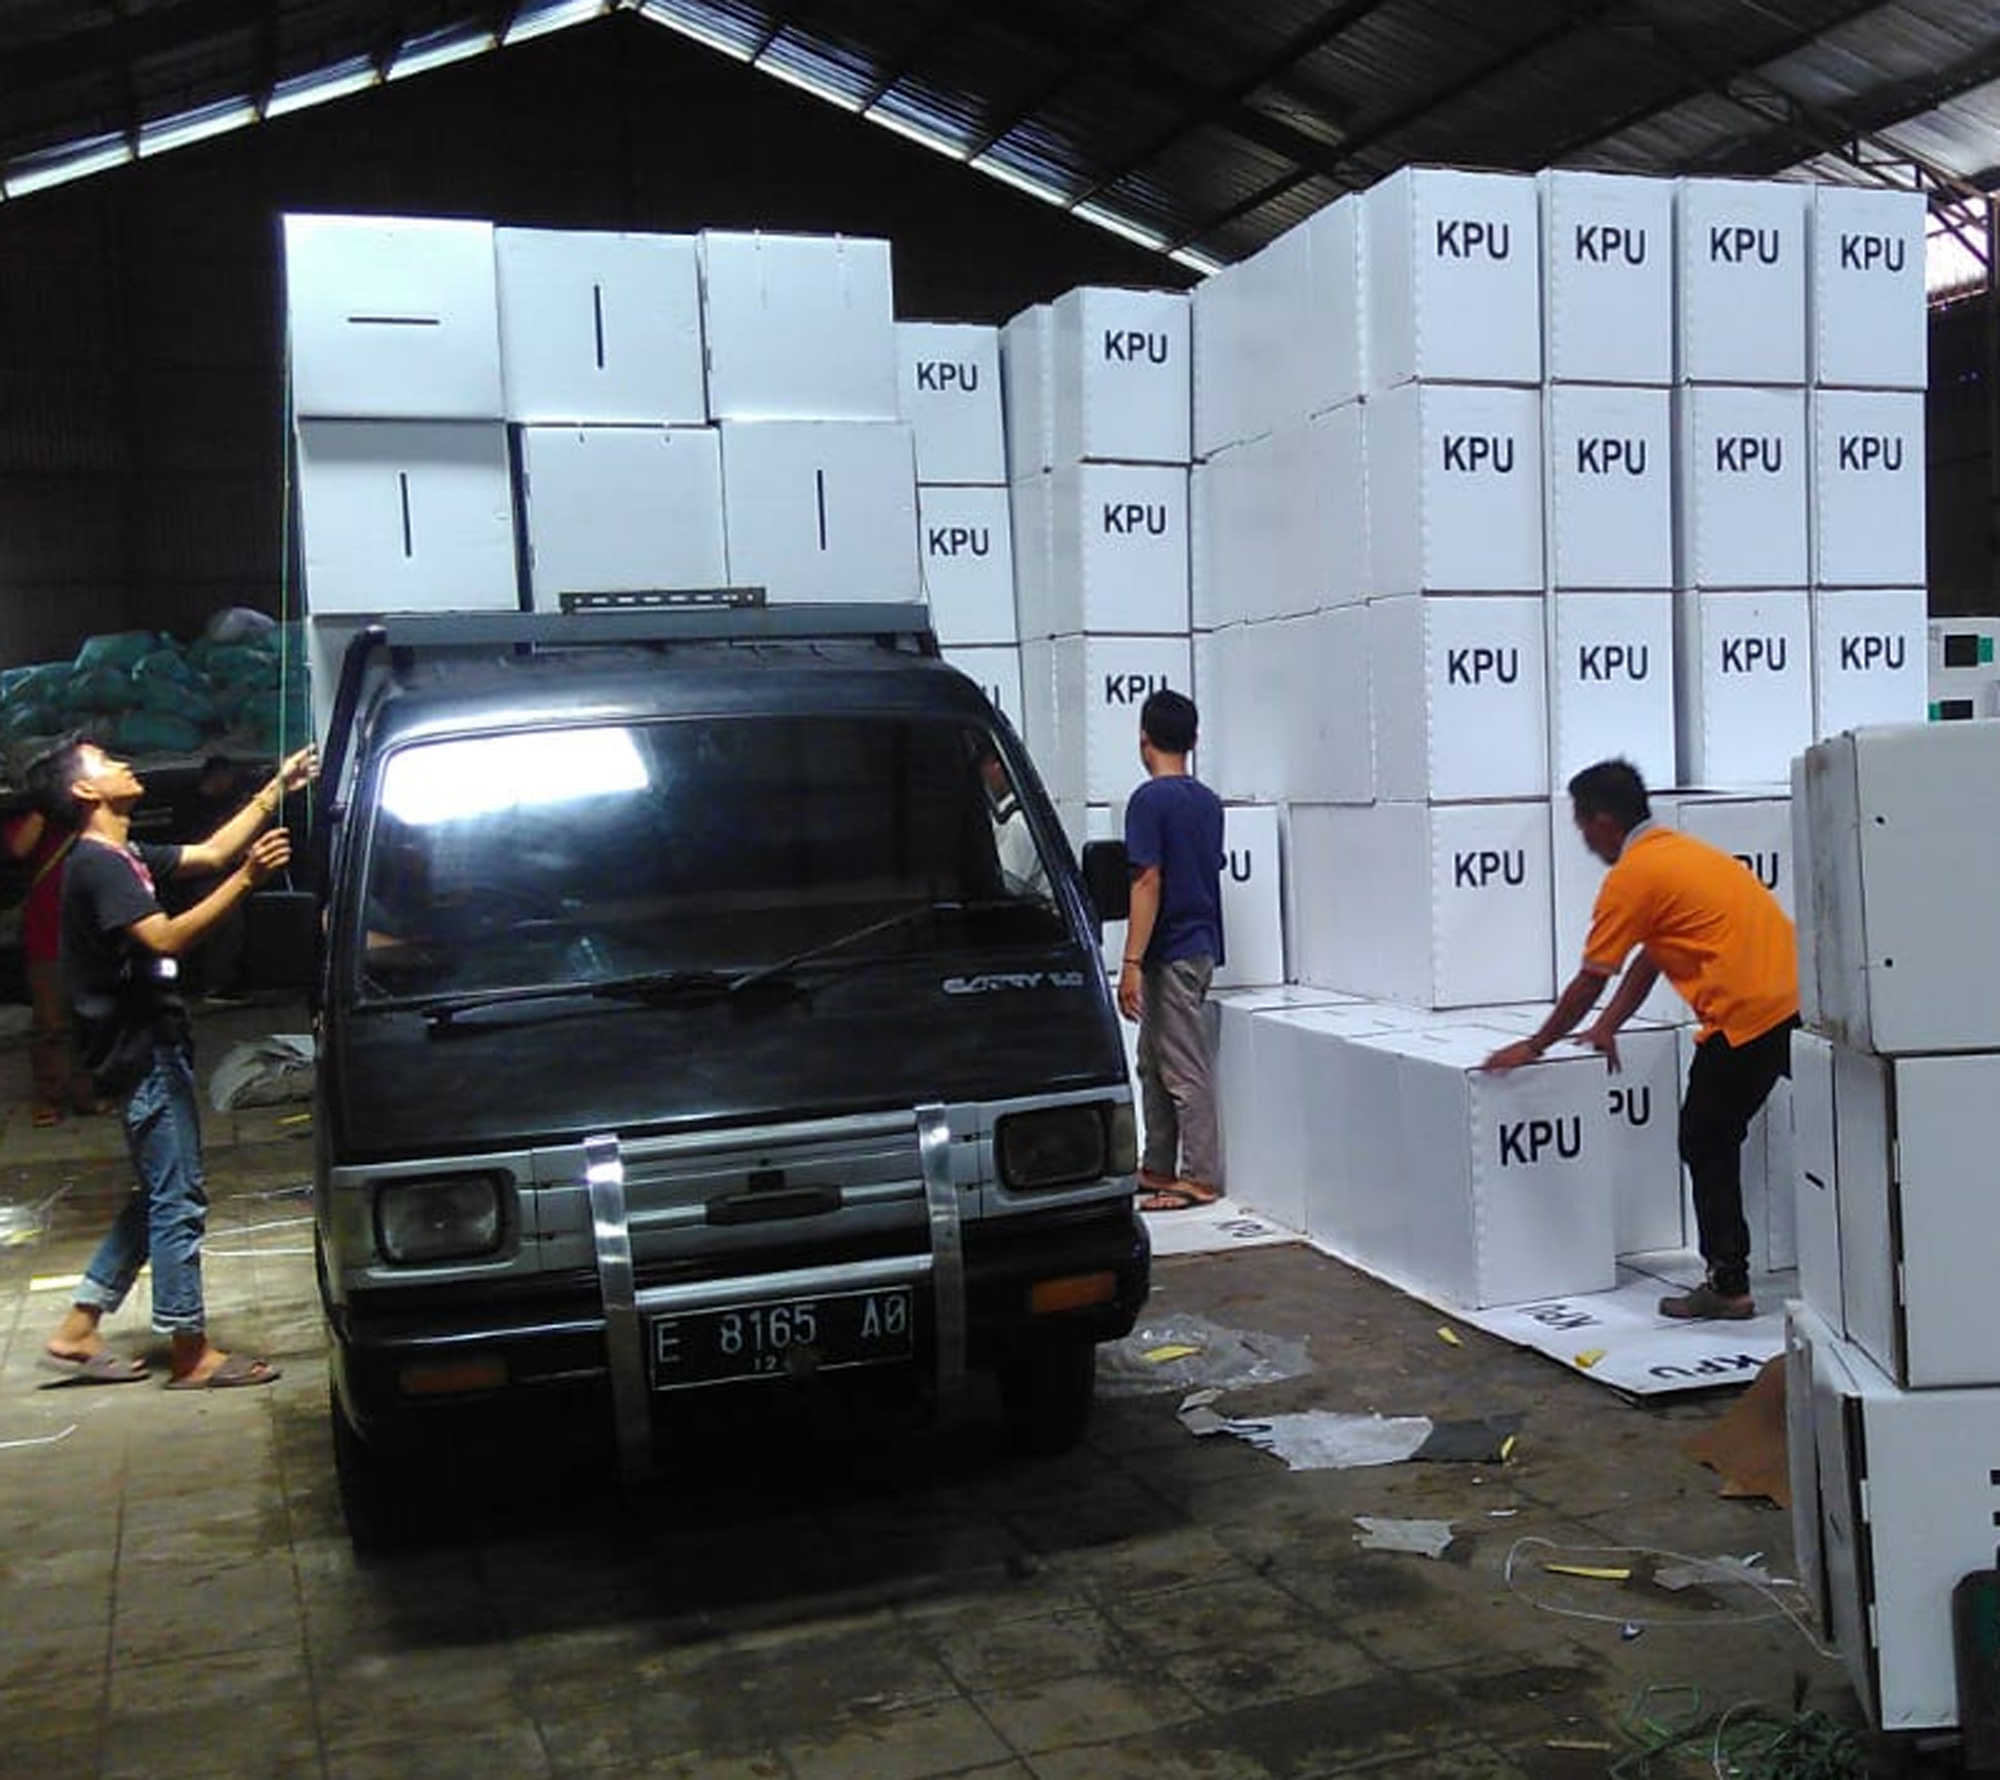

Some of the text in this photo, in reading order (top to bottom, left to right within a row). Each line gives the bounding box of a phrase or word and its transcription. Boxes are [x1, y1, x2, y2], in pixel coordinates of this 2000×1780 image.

[1436, 220, 1509, 259] KPU
[1576, 226, 1646, 265] KPU
[1711, 227, 1779, 264] KPU
[1841, 235, 1904, 272] KPU
[1105, 330, 1168, 363] KPU
[917, 362, 978, 392] KPU
[1443, 435, 1514, 473] KPU
[1577, 438, 1646, 475] KPU
[1716, 437, 1782, 472] KPU
[1839, 436, 1902, 471] KPU
[1104, 504, 1166, 535] KPU
[929, 528, 989, 556] KPU
[1448, 649, 1518, 684] KPU
[1580, 646, 1648, 680] KPU
[1722, 638, 1786, 673] KPU
[1841, 636, 1905, 670] KPU
[1455, 850, 1524, 887] KPU
[1609, 1086, 1649, 1126] PU
[1499, 1116, 1581, 1166] KPU
[657, 1322, 681, 1362] E
[721, 1304, 816, 1353] 8165
[1649, 1354, 1767, 1380] KPU
